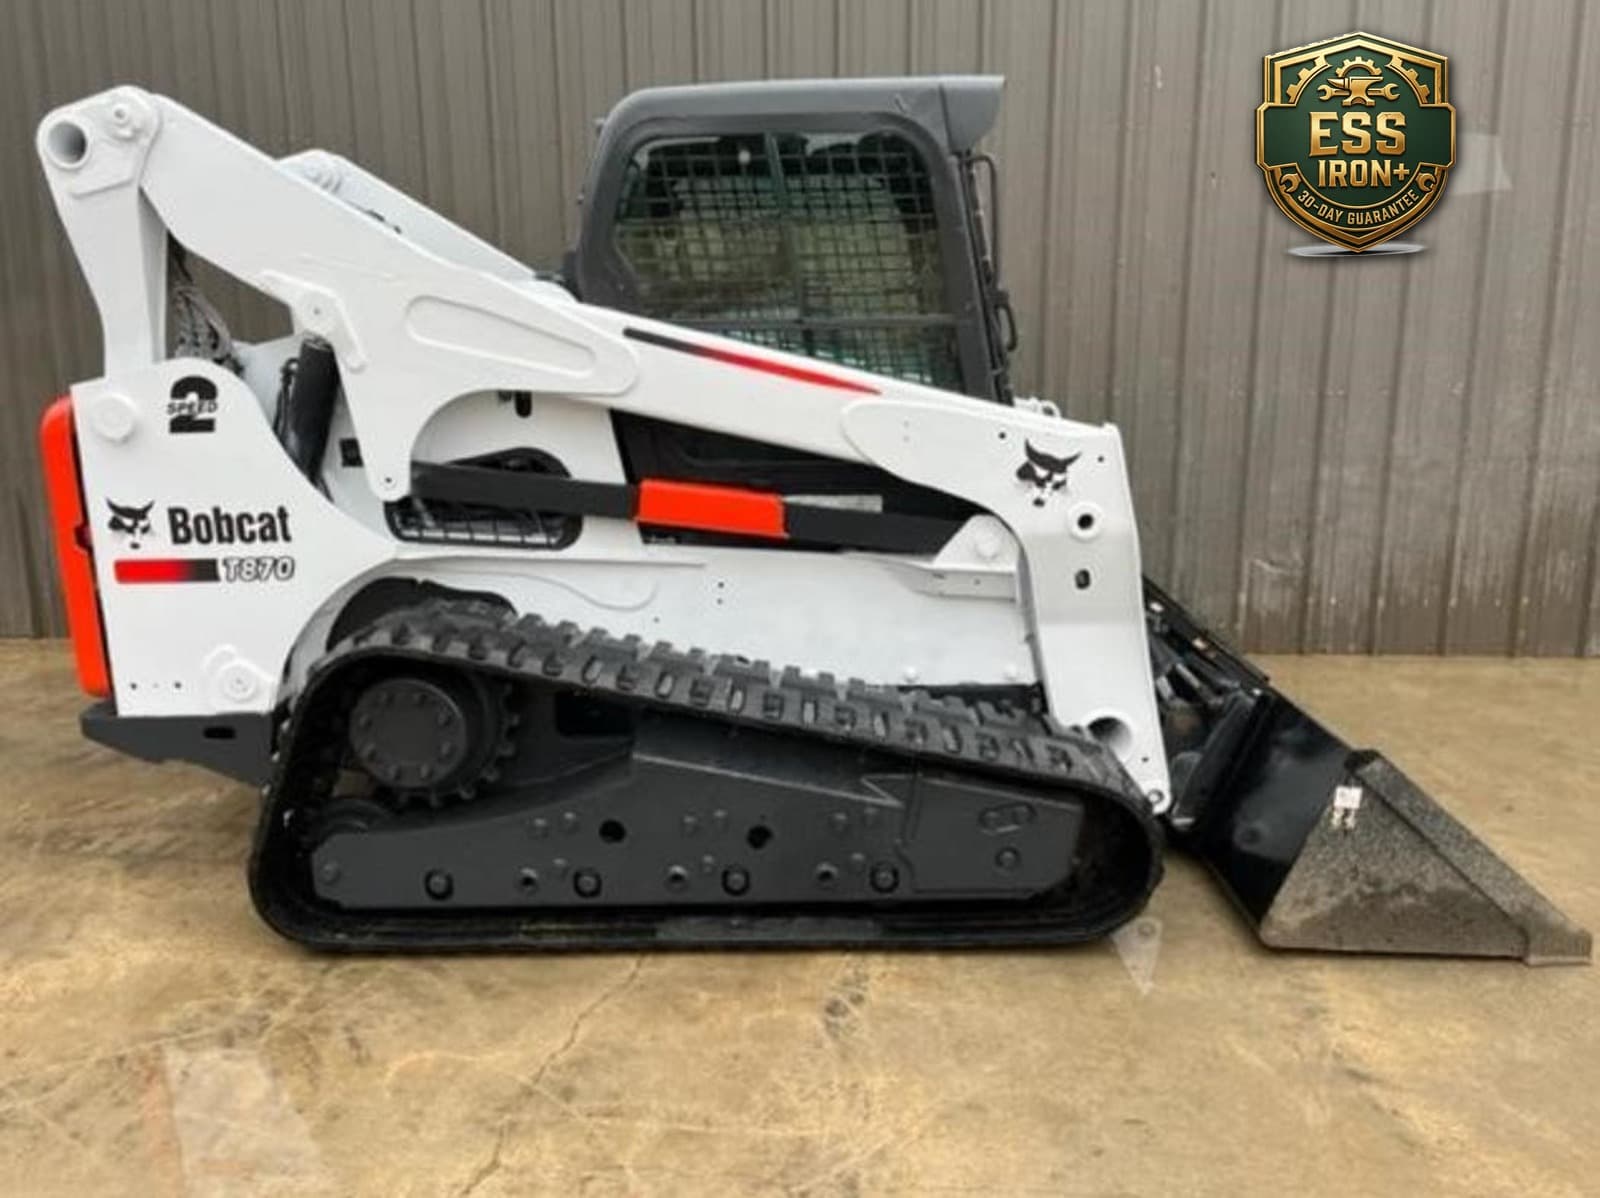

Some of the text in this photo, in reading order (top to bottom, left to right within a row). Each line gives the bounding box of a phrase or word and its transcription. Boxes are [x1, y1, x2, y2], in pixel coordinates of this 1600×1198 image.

[167, 401, 218, 415] SPEED
[168, 375, 218, 433] 2
[167, 505, 292, 545] Bobcat
[222, 555, 295, 582] T870
